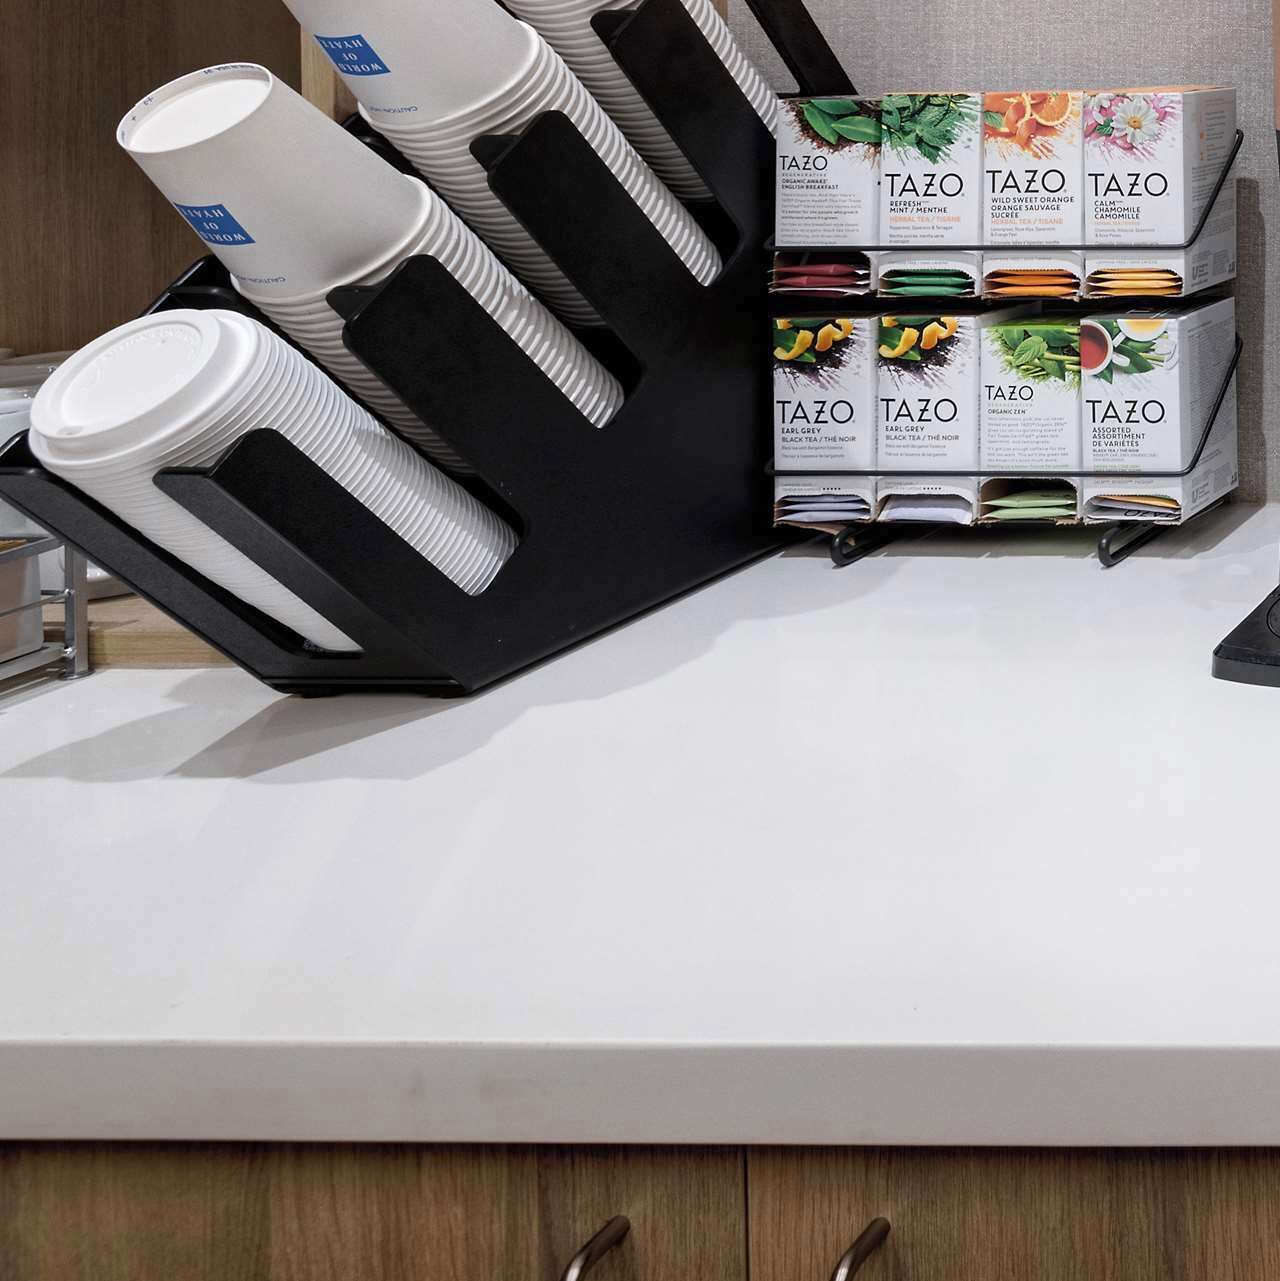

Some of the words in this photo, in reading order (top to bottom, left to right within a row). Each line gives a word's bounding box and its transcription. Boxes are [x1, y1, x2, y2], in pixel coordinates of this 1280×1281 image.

[342, 53, 358, 61] OF
[779, 155, 828, 170] TAZO
[885, 173, 963, 197] TAZO
[986, 169, 1065, 193] TAZO
[1088, 173, 1168, 196] TAZO
[203, 222, 218, 230] OF
[984, 385, 1033, 400] TAZO
[776, 400, 854, 424] TAZO
[880, 398, 958, 422] TAZO
[1086, 400, 1165, 424] TAZO
